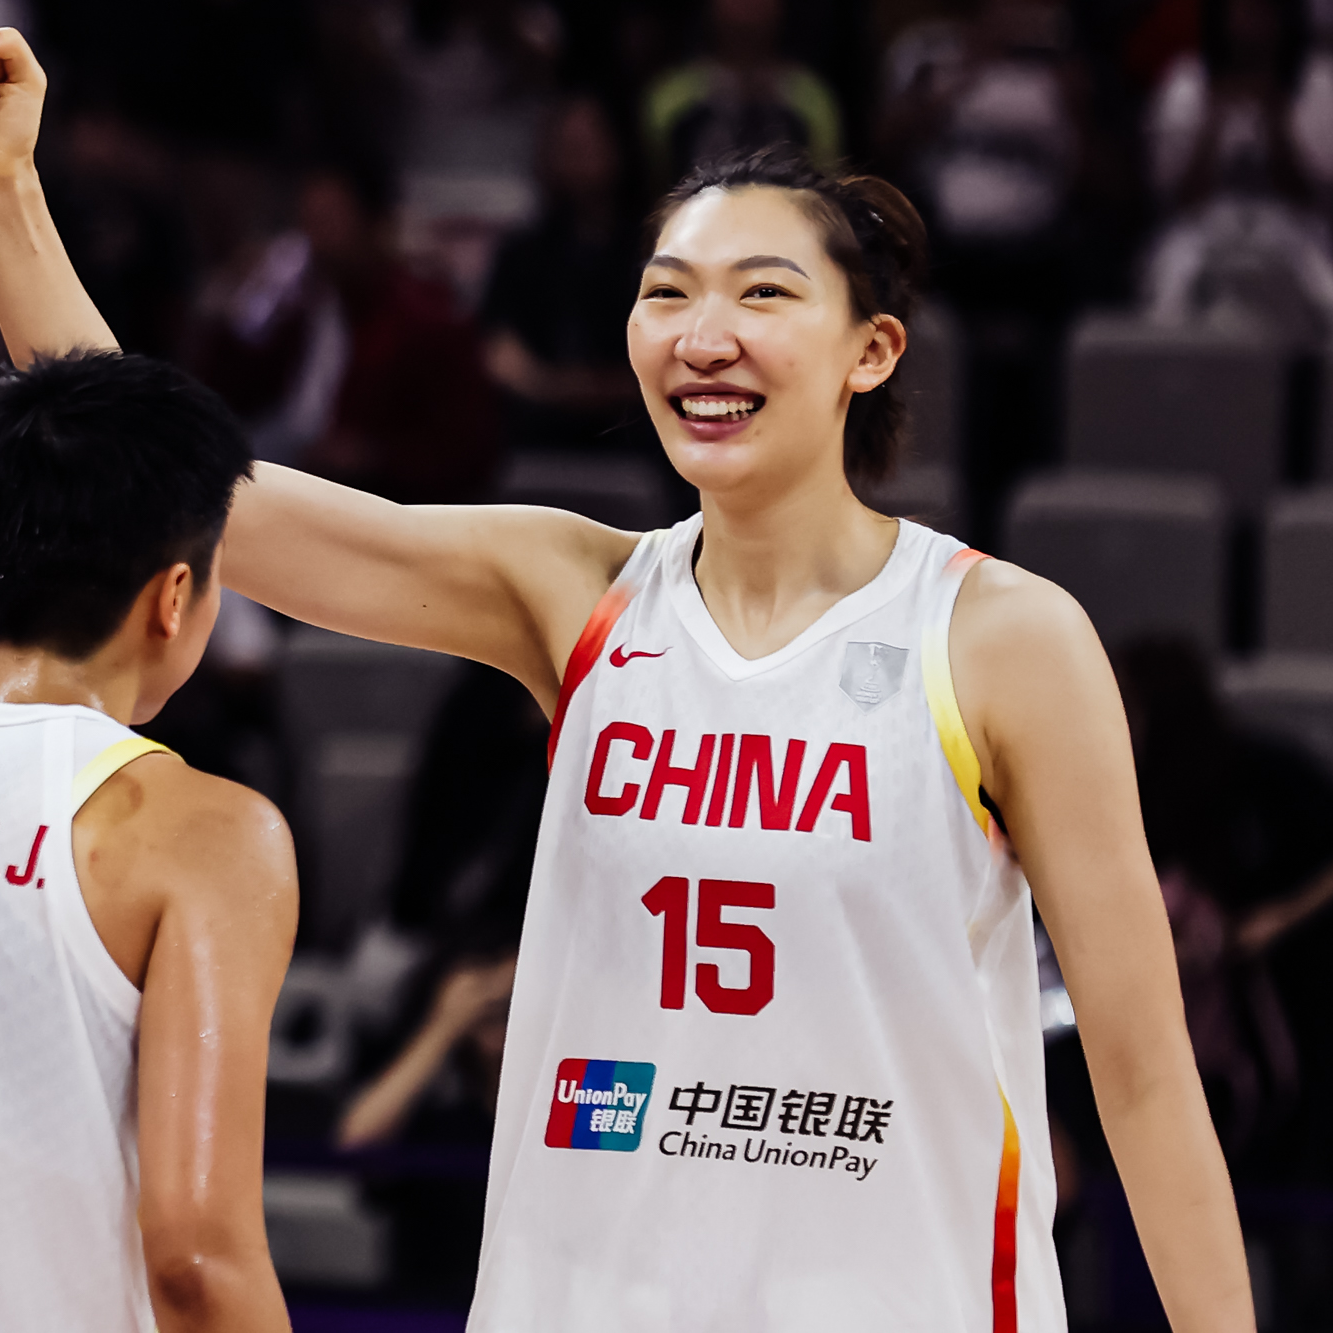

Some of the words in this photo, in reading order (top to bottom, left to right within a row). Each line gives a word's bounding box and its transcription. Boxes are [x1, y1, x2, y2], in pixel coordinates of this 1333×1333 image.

[584, 720, 873, 843] CHINA
[641, 876, 776, 1016] 15
[557, 1079, 648, 1109] UnionPay
[589, 1108, 638, 1135] 银联
[668, 1081, 895, 1145] 中国银联
[658, 1131, 736, 1162] China
[743, 1137, 879, 1182] UnionPay
